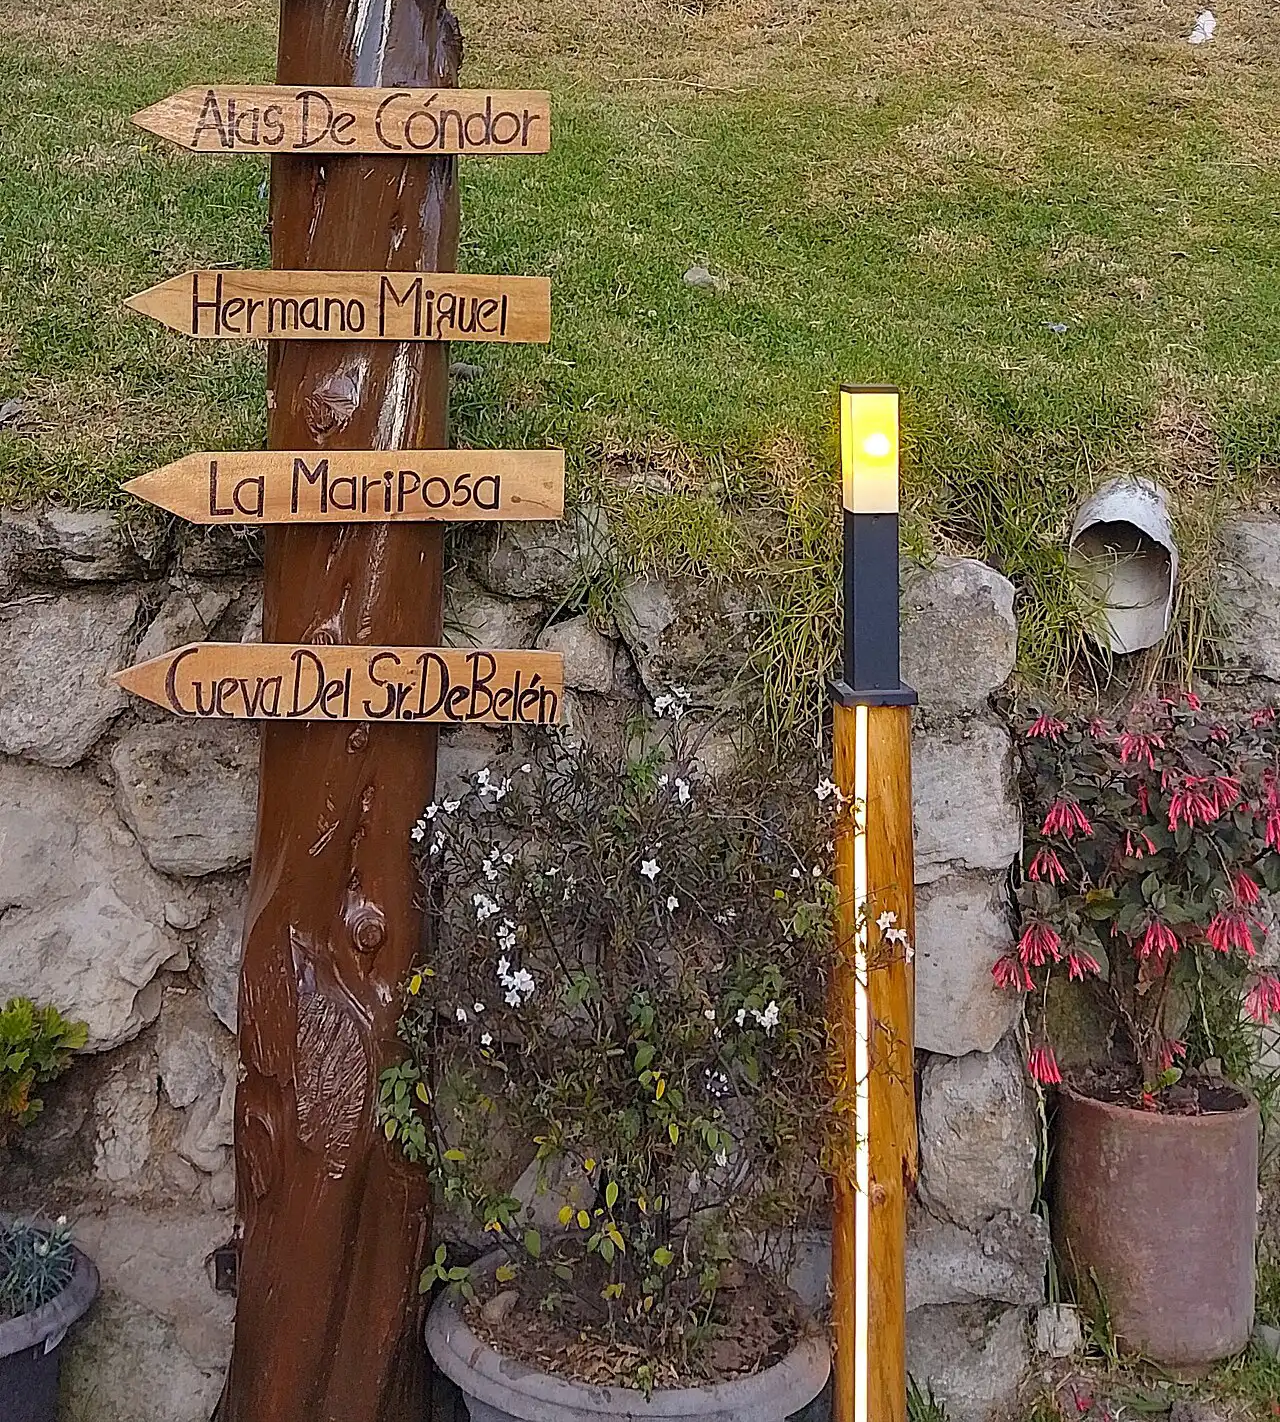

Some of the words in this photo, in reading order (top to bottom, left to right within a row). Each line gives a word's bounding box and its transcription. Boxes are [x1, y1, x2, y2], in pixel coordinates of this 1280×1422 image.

[191, 89, 285, 149] Alas
[293, 91, 356, 148] De
[375, 93, 540, 150] Cóndor
[192, 273, 365, 336] Hermano
[379, 276, 508, 339] Miguel
[209, 461, 264, 518] La
[164, 647, 282, 718] Cueva
[287, 649, 351, 719] Del
[465, 651, 558, 724] Belén
